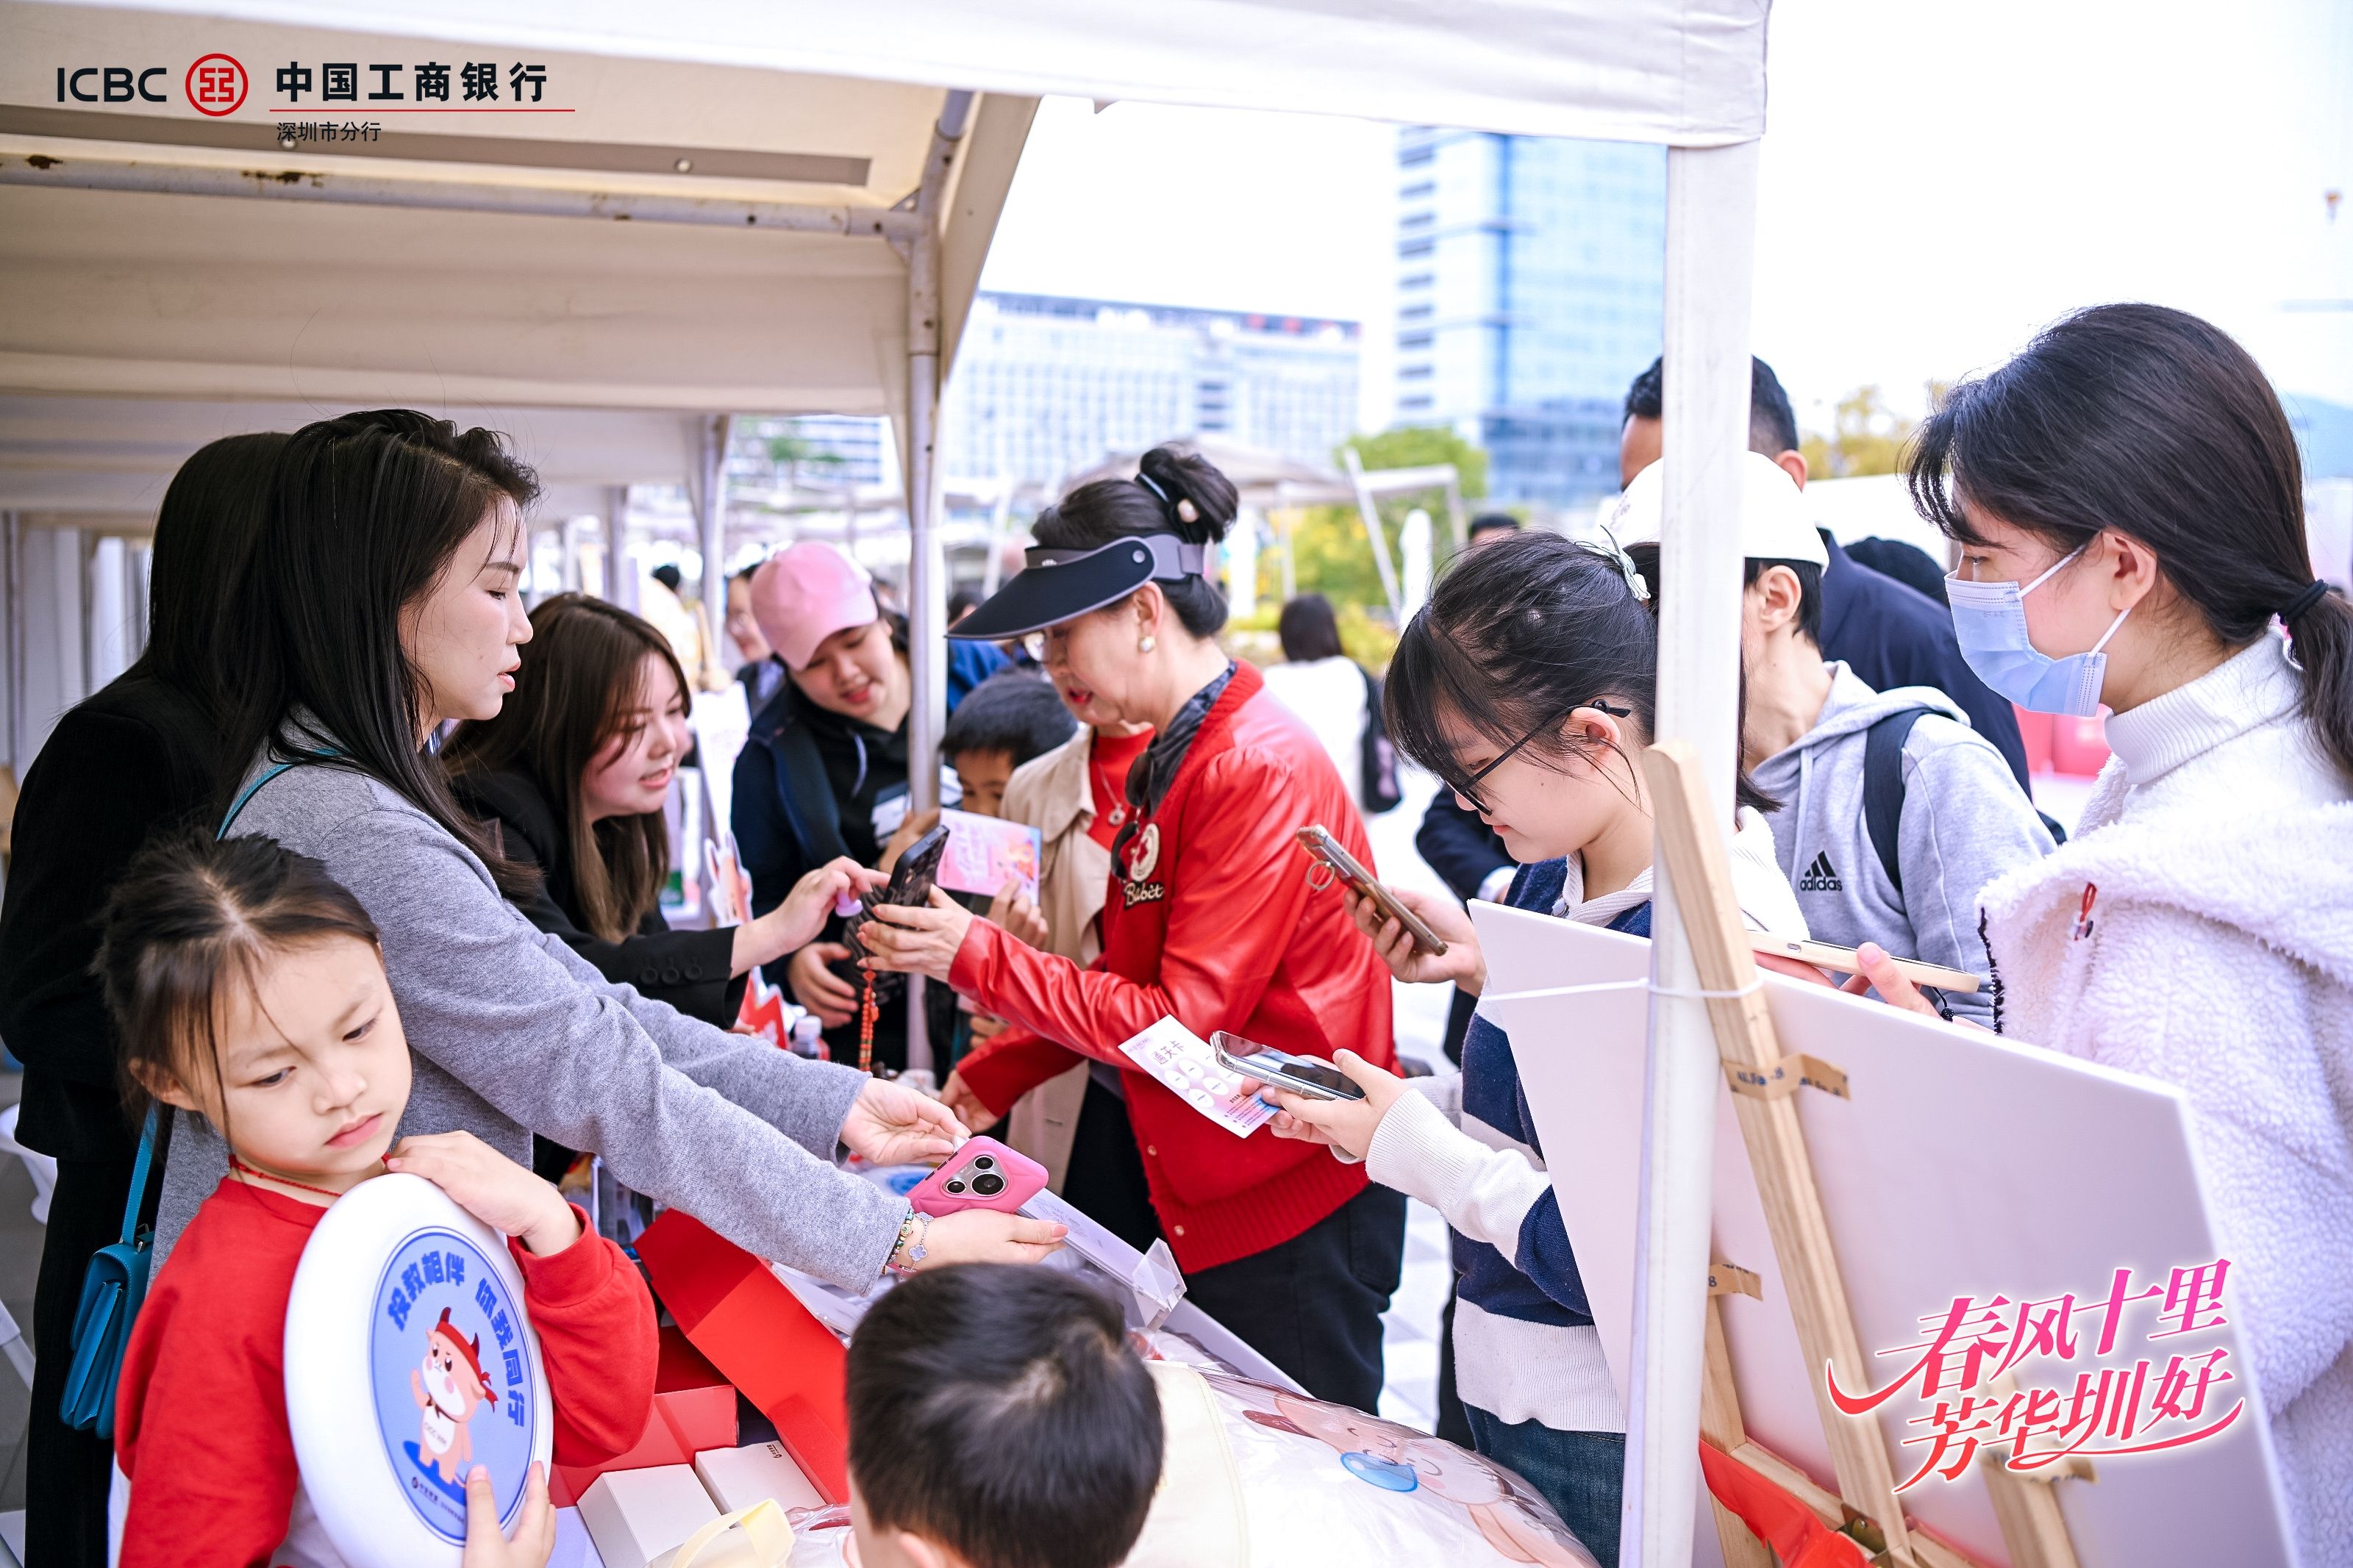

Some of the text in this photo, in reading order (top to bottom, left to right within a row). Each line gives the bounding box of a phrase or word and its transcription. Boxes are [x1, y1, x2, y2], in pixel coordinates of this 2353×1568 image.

[1800, 876, 1843, 892] adidas
[387, 1250, 525, 1428] 投教相伴 你我同行
